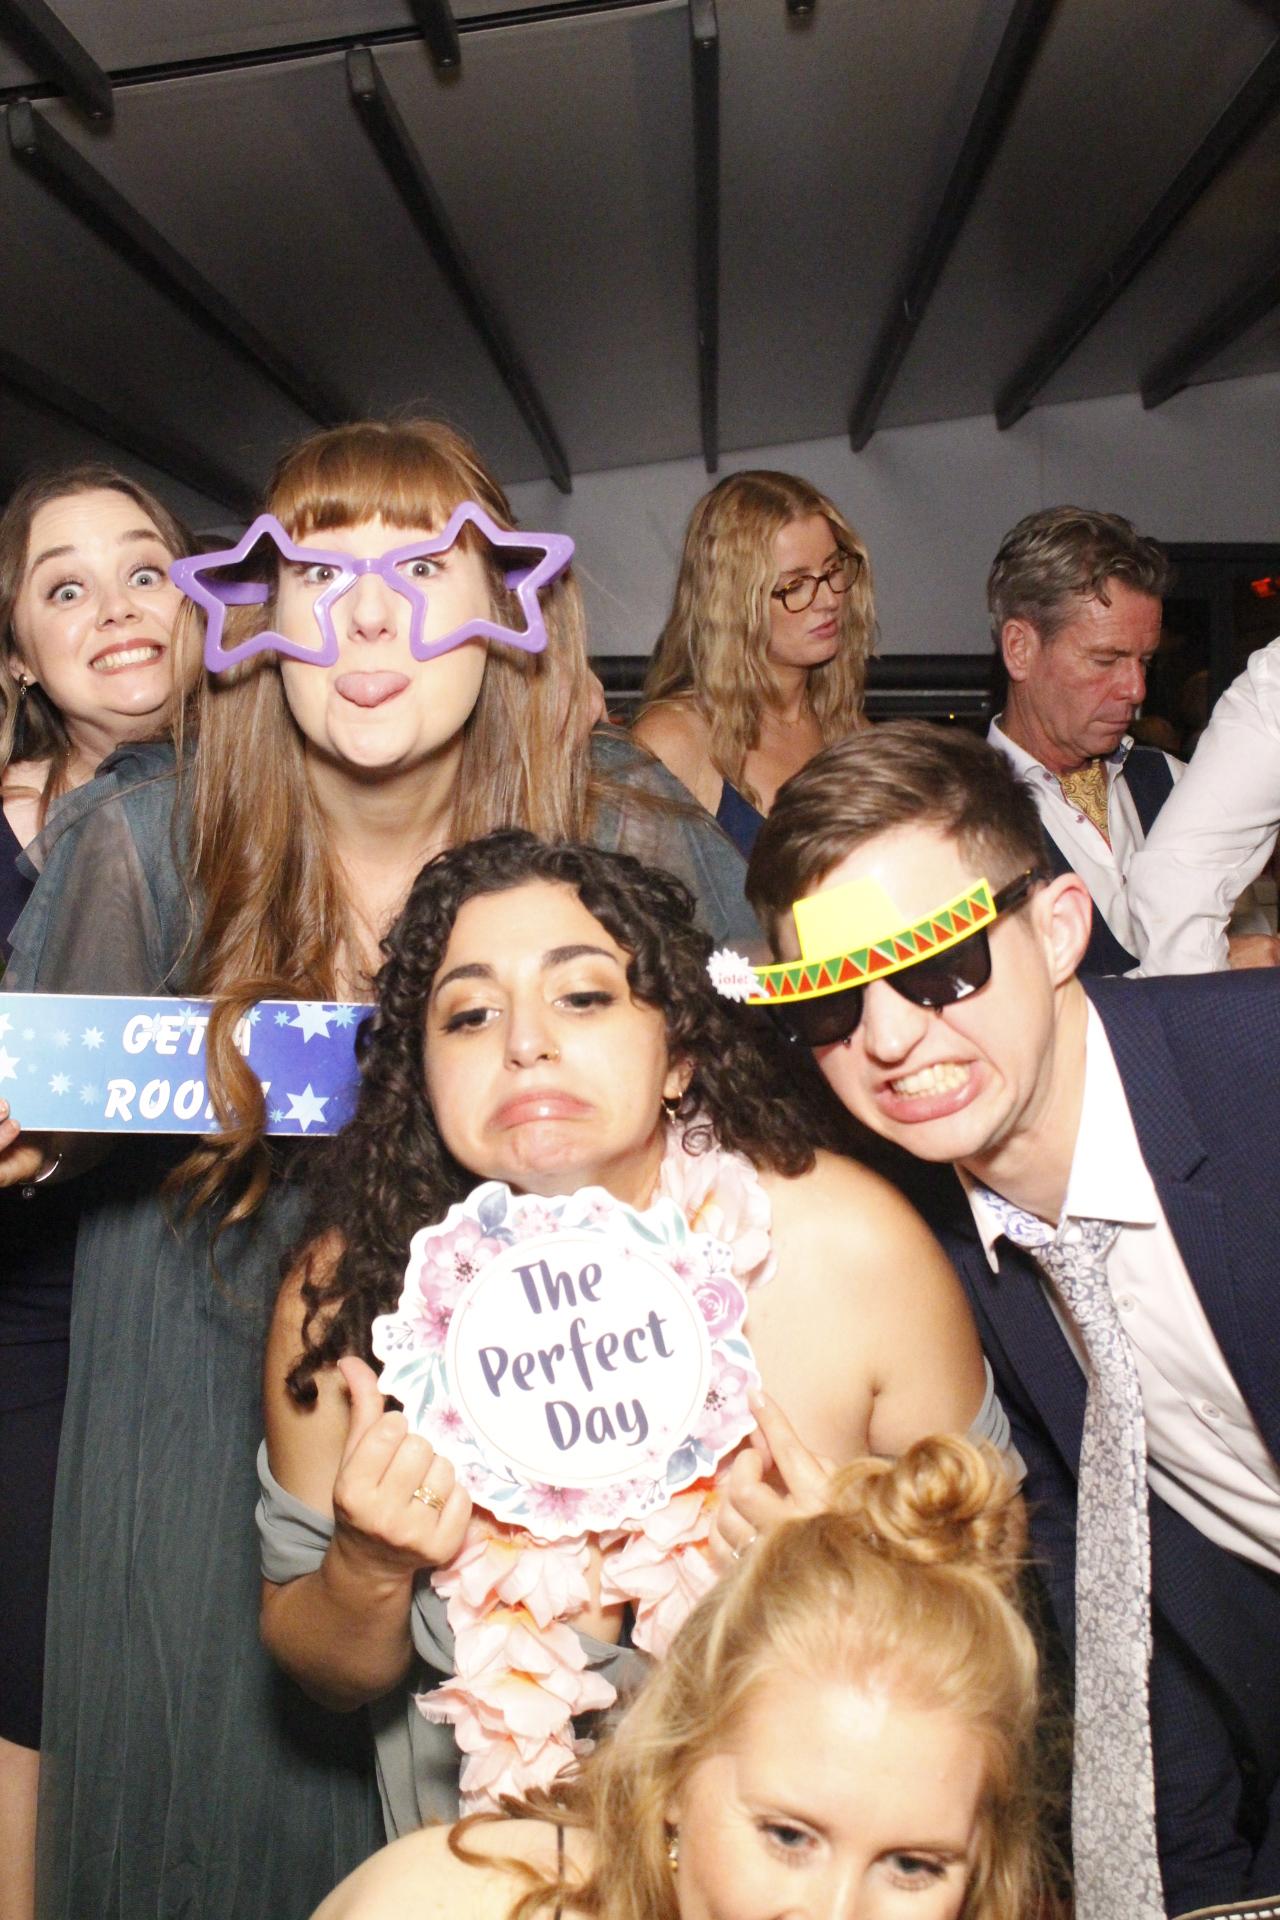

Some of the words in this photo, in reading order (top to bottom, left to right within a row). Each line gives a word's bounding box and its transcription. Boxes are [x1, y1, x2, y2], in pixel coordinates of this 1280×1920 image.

[122, 1014, 209, 1055] GET
[512, 1259, 602, 1314] The
[479, 1311, 674, 1397] Perfect
[545, 1399, 649, 1451] Day
